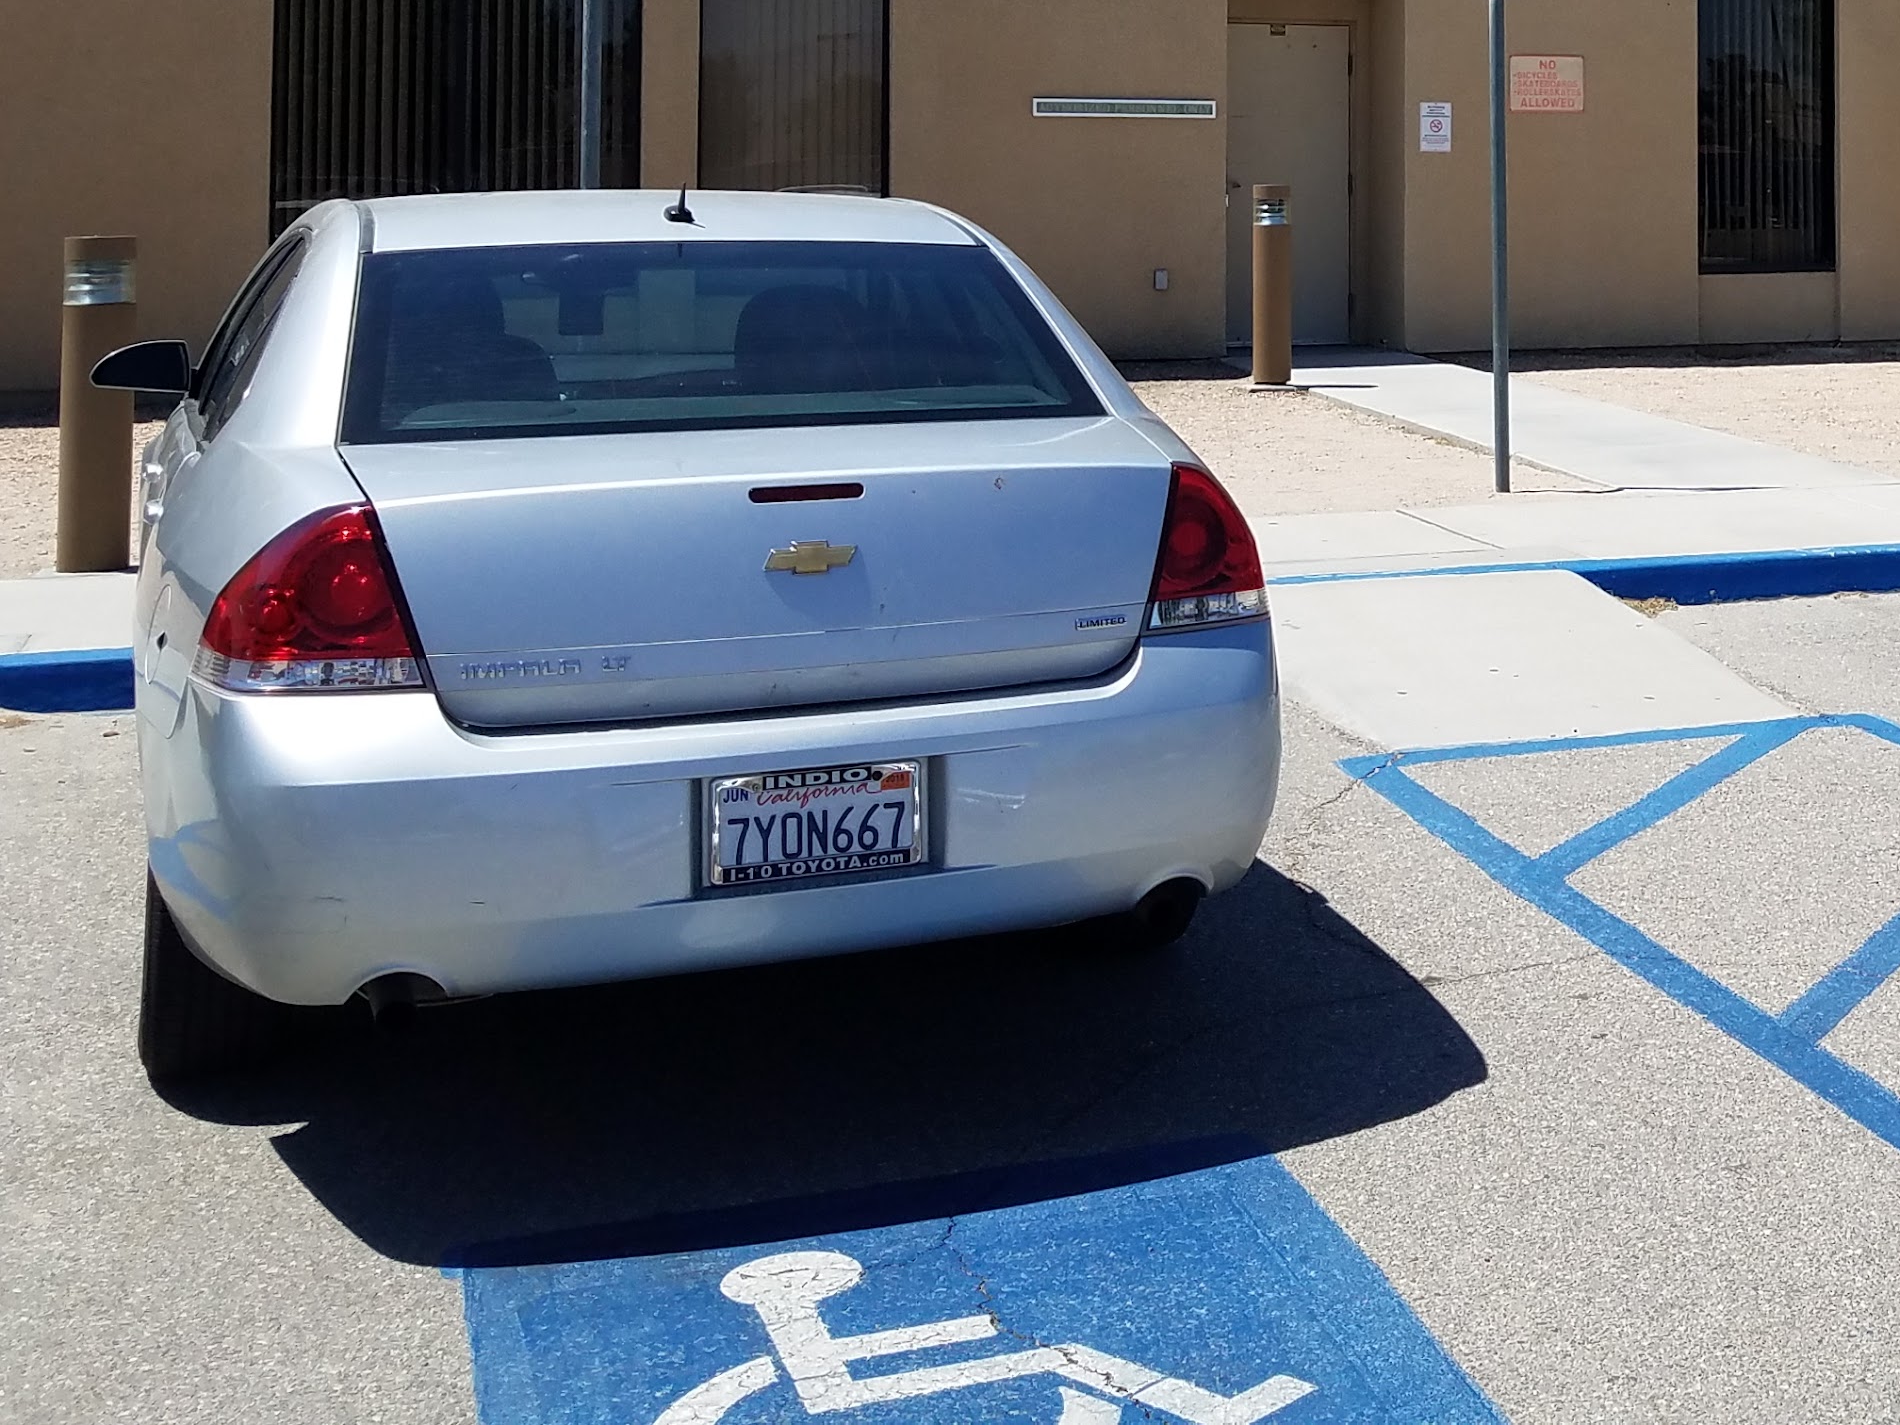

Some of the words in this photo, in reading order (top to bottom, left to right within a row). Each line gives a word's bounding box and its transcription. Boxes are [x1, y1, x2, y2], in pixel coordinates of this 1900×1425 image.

[1539, 60, 1556, 70] NO
[1521, 98, 1575, 108] ALLOWED
[1077, 616, 1127, 629] LIMITED
[460, 658, 581, 679] IMPALA
[602, 655, 631, 672] LT
[765, 768, 868, 790] INDIO
[723, 788, 749, 803] JUN
[756, 782, 881, 809] California
[727, 801, 905, 865] 7YON667
[730, 865, 772, 881] I-10
[778, 853, 904, 875] TOYOTA.com
